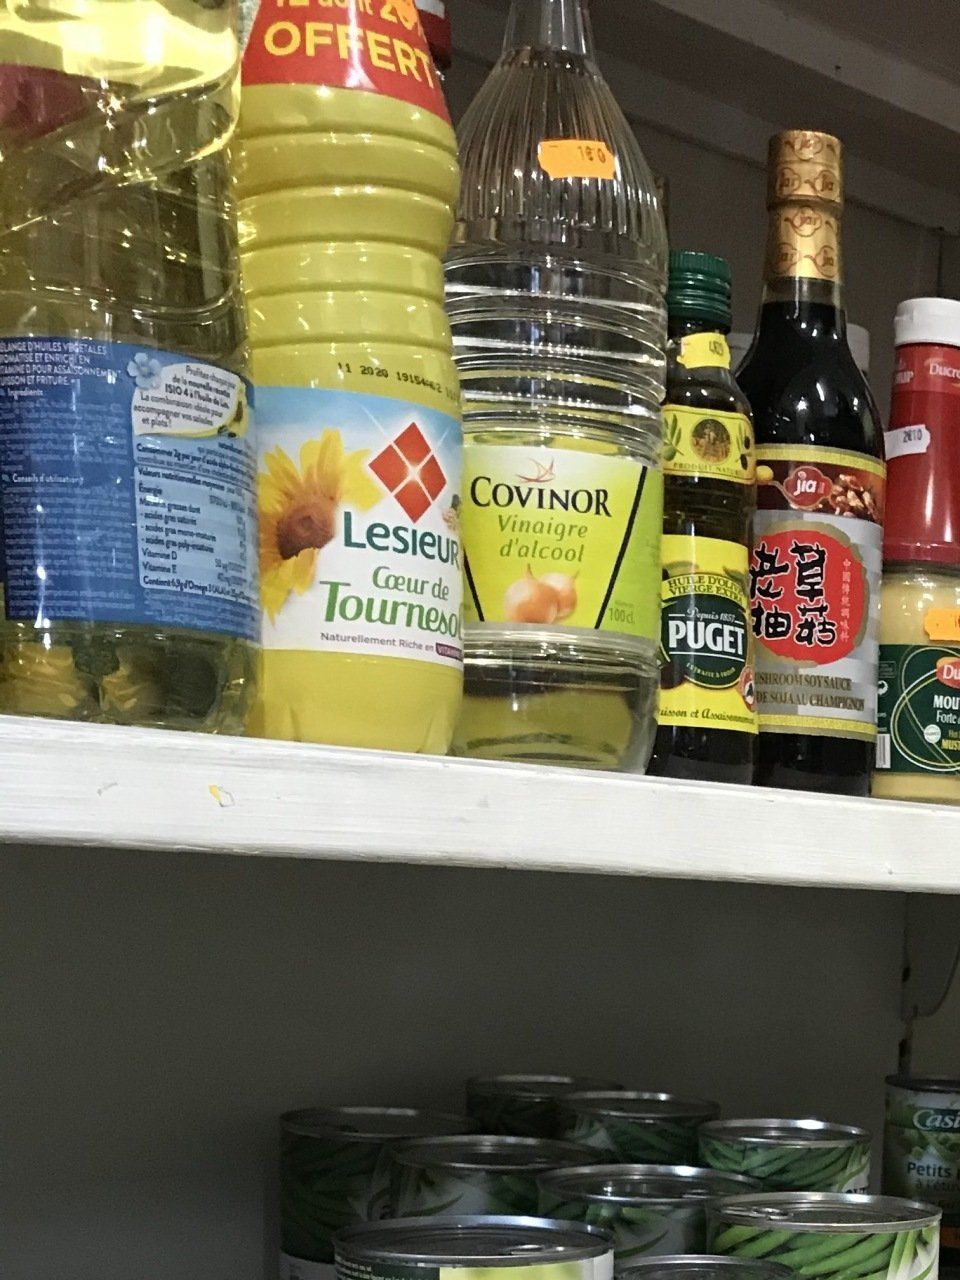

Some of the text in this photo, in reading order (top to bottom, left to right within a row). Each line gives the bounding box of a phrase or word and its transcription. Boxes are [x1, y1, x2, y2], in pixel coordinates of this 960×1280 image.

[264, 21, 435, 89] OFFERT
[793, 470, 818, 496] jia
[470, 476, 612, 517] COVINOR
[498, 514, 589, 541] Vinaigre
[499, 539, 585, 562] d'alcool
[373, 566, 449, 601] Cœur de
[320, 632, 396, 647] Naturellement
[398, 639, 422, 651] Riche
[668, 619, 745, 656] PUGET
[805, 674, 822, 688] SOY
[936, 710, 957, 725] Forte
[907, 1161, 951, 1178] Petits
